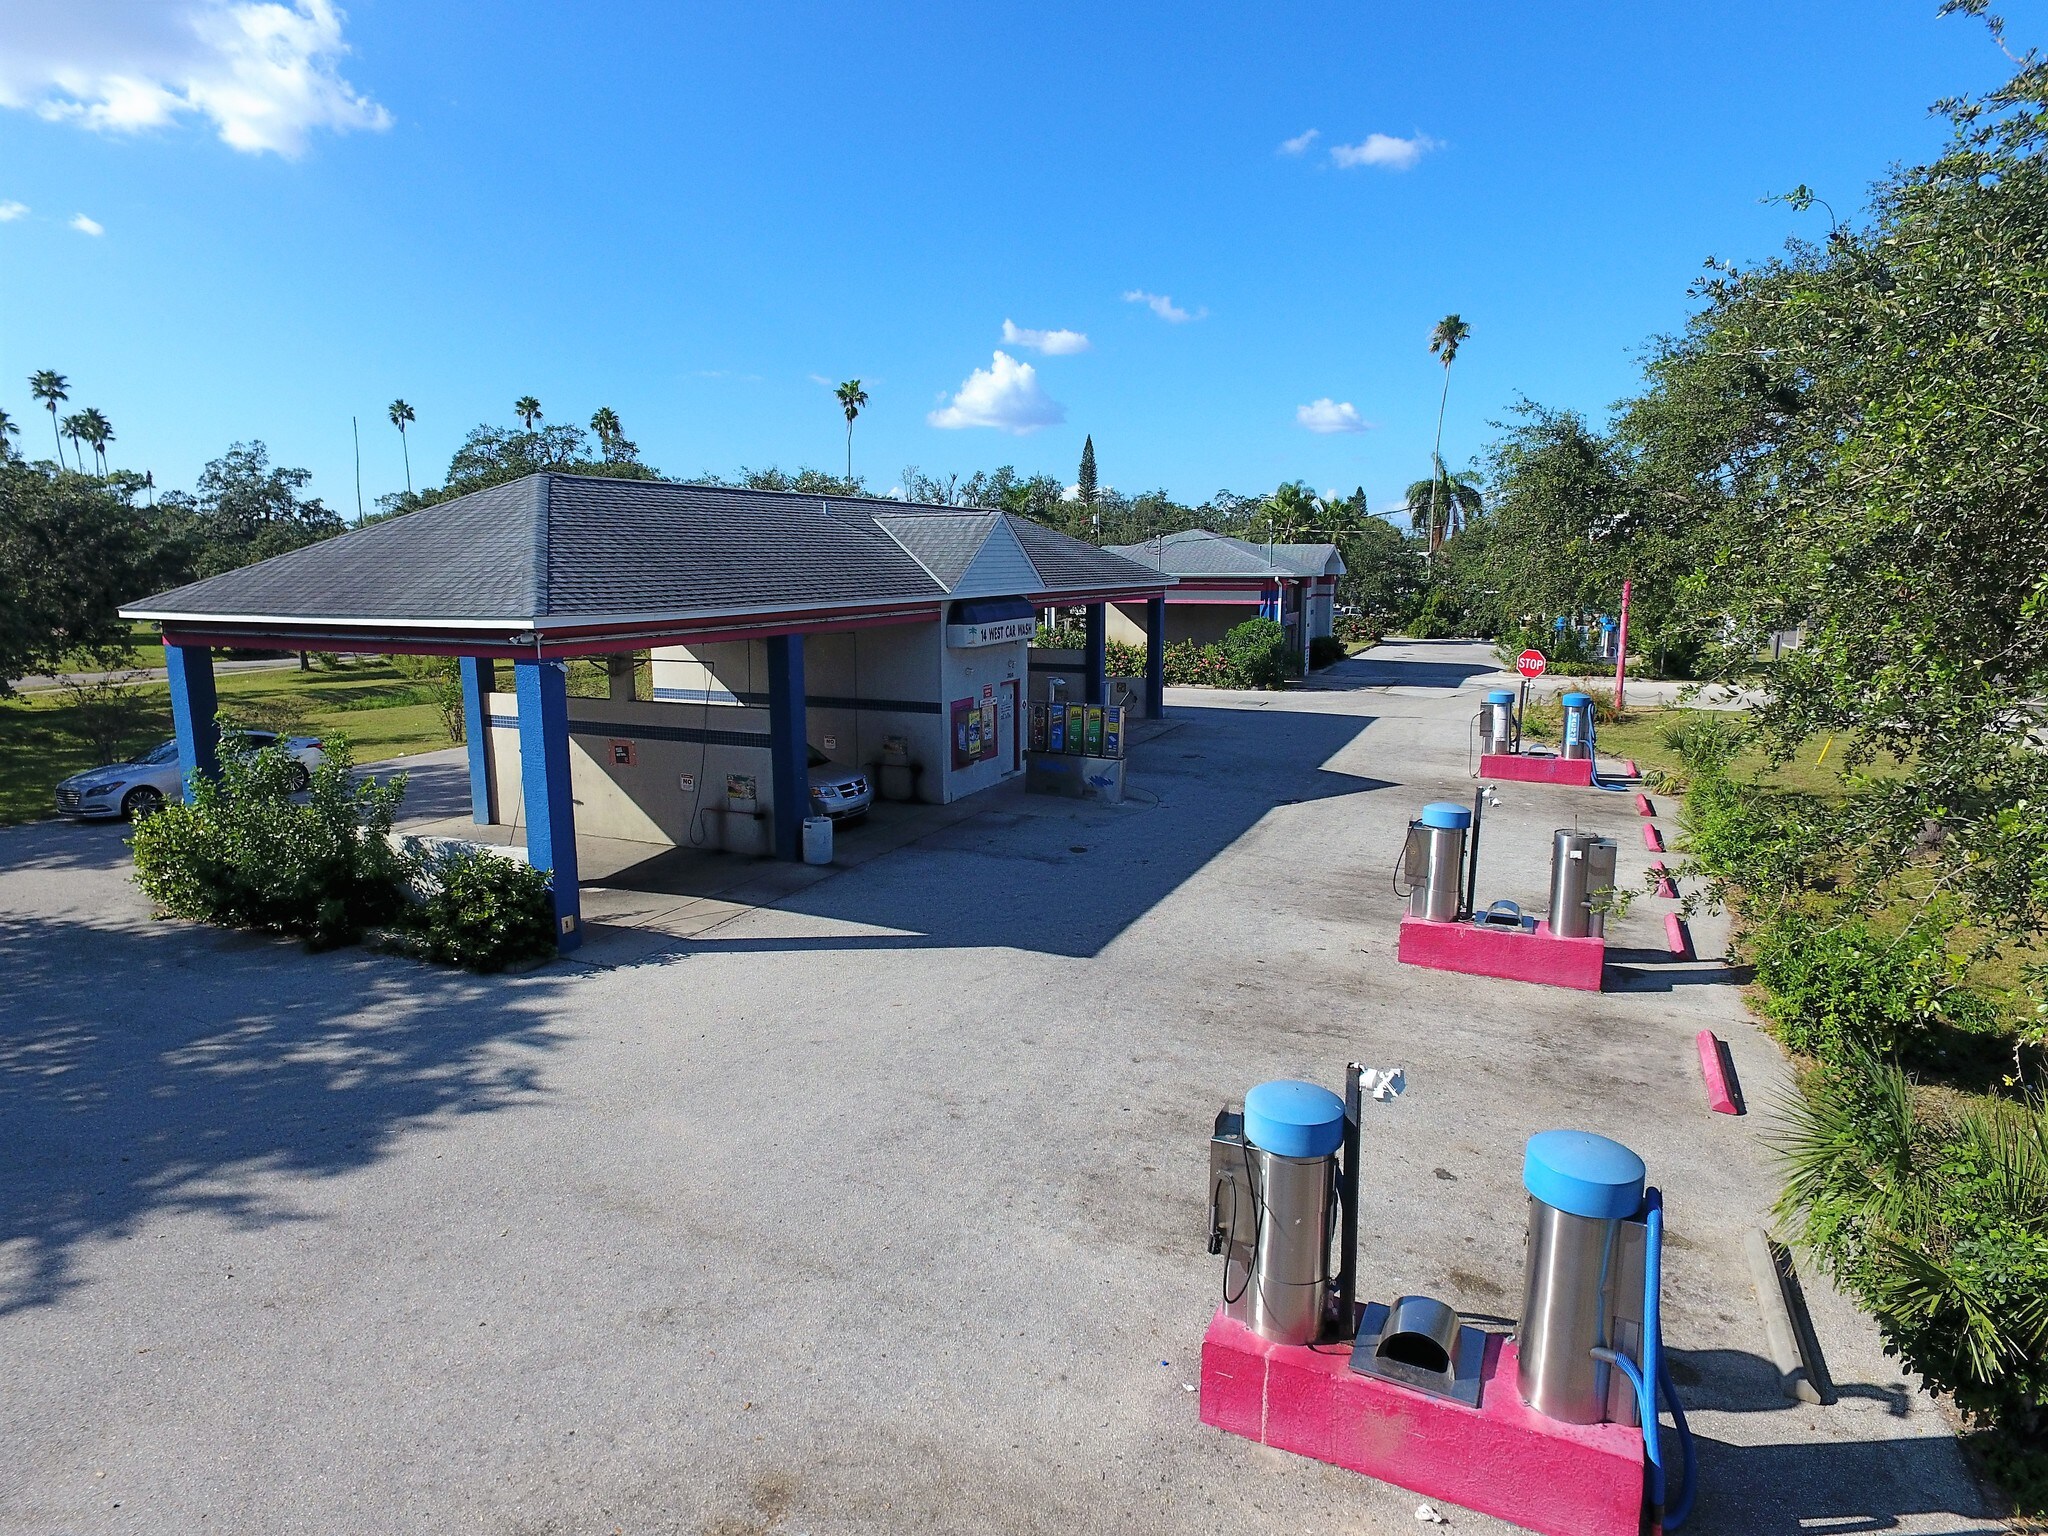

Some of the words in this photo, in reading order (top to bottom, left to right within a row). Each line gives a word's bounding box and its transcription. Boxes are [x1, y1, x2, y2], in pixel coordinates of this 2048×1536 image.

[981, 629, 987, 642] 14
[989, 626, 1004, 641] WEST
[1005, 624, 1016, 638] CAR
[1017, 623, 1032, 636] WASH
[1519, 657, 1544, 670] STOP
